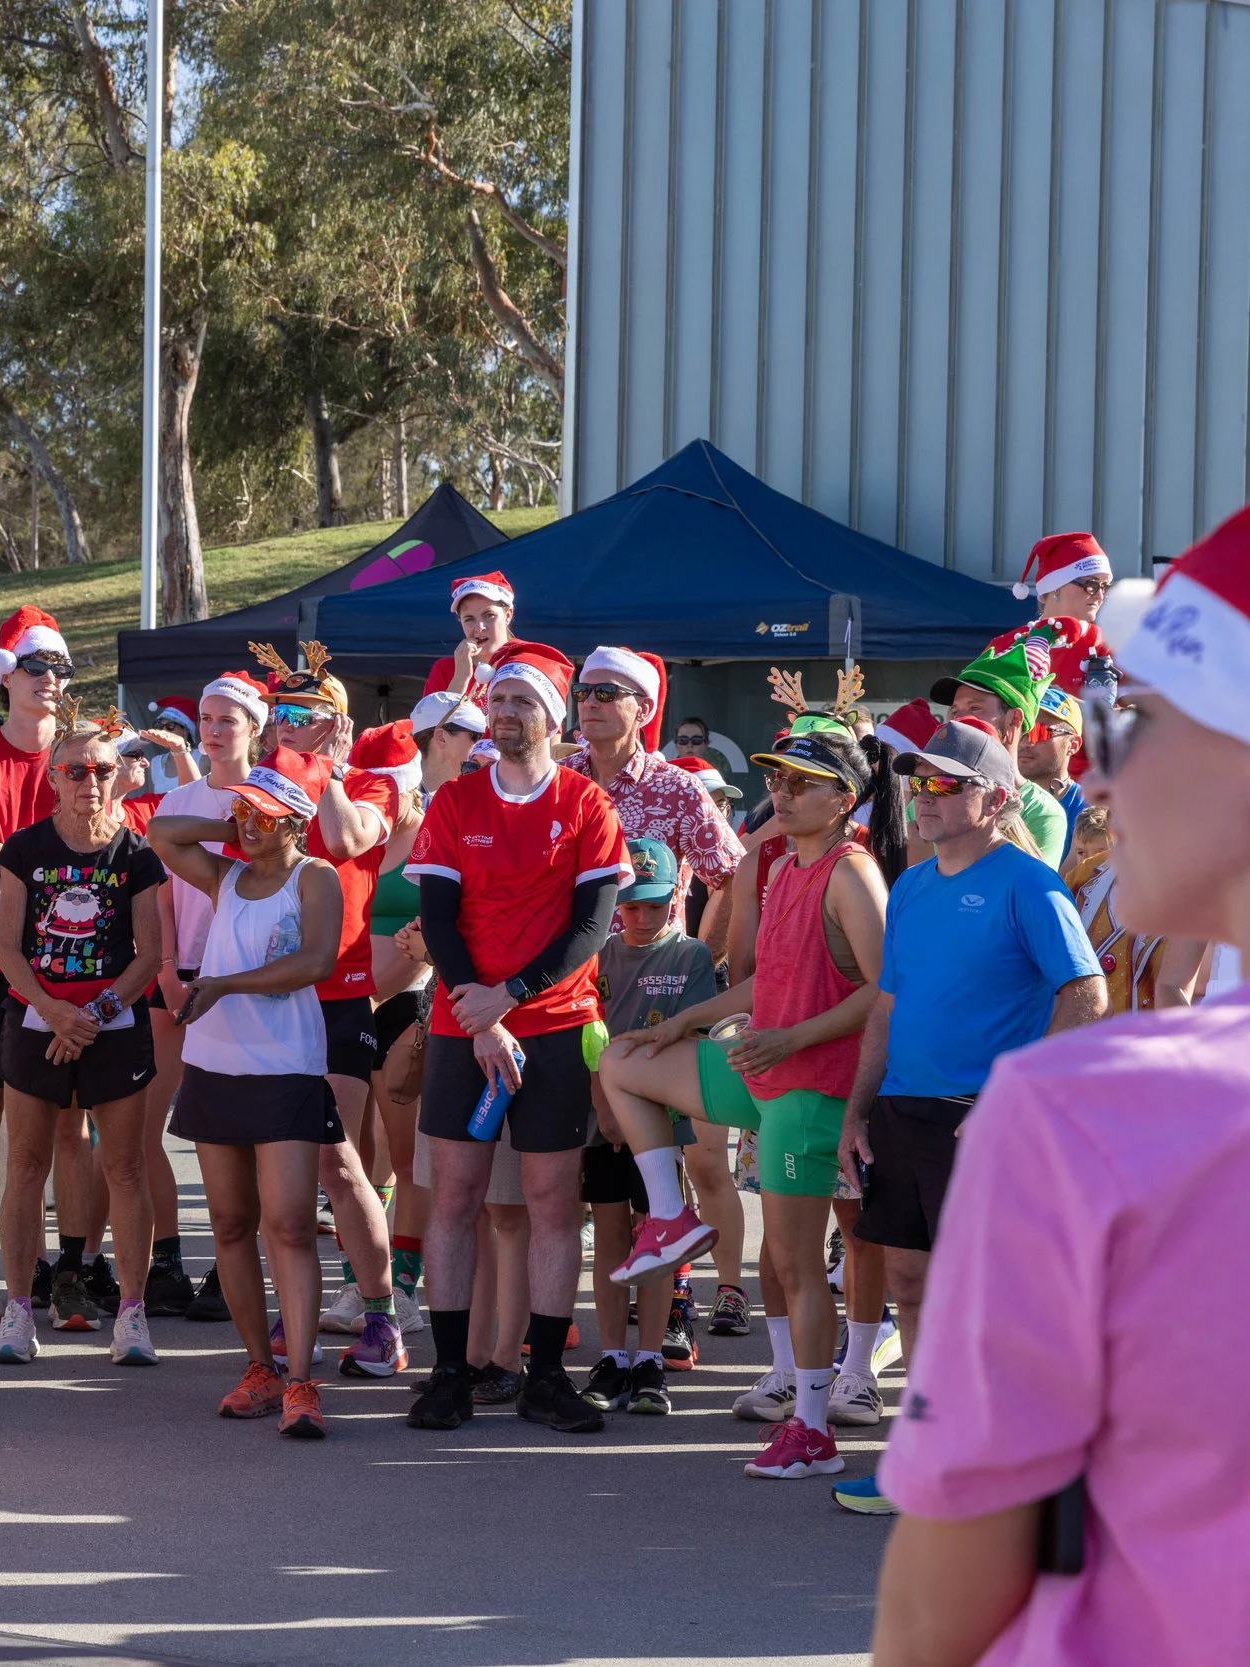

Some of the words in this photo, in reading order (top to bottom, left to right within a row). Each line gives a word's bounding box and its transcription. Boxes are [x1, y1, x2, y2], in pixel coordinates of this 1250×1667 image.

[770, 623, 809, 633] OZtrail
[514, 665, 542, 682] Santa
[542, 680, 554, 698] Run
[258, 773, 286, 792] Santa
[285, 787, 300, 803] Run
[32, 865, 128, 888] CHRISTMAS
